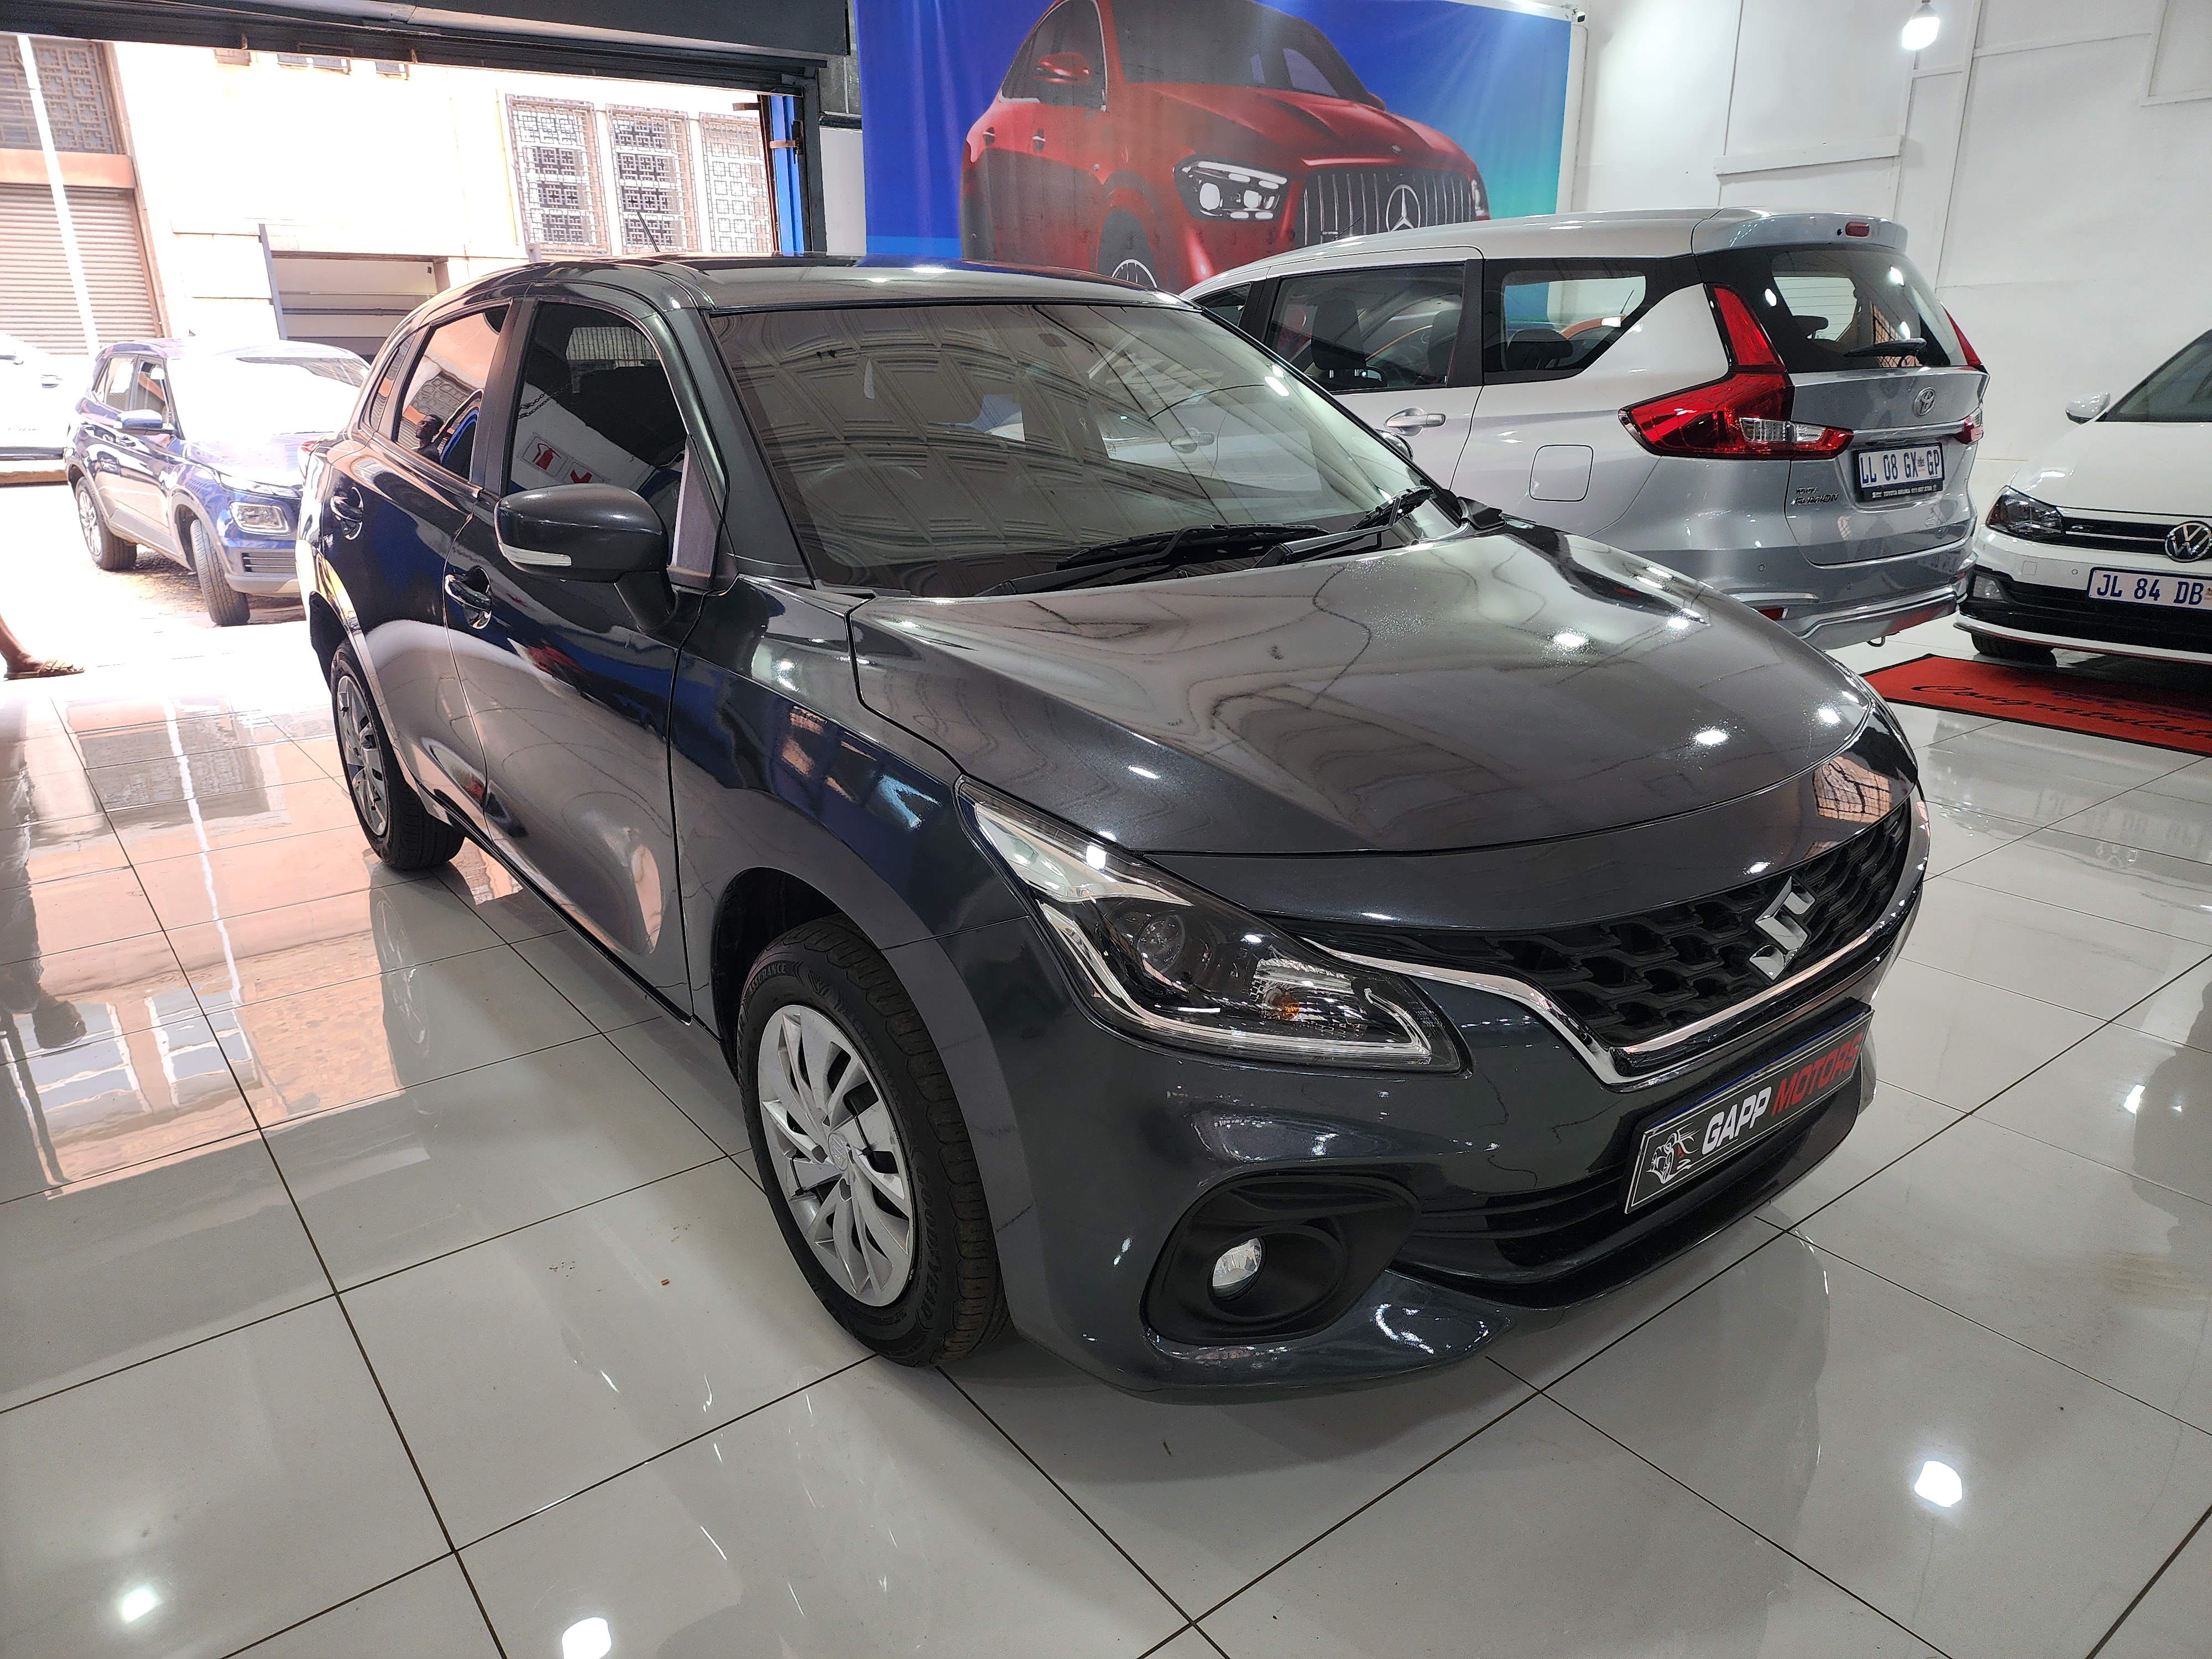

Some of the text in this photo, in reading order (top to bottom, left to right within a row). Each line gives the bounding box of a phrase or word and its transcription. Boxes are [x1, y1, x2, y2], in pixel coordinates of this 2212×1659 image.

[1860, 450, 1940, 484] LL 08 GX GP
[2096, 574, 2204, 604] JL 84 DB
[749, 963, 786, 995] ASSURANCE
[1702, 1032, 1863, 1155] GAPP MOTORS
[916, 1165, 941, 1320] GOODYEAR
